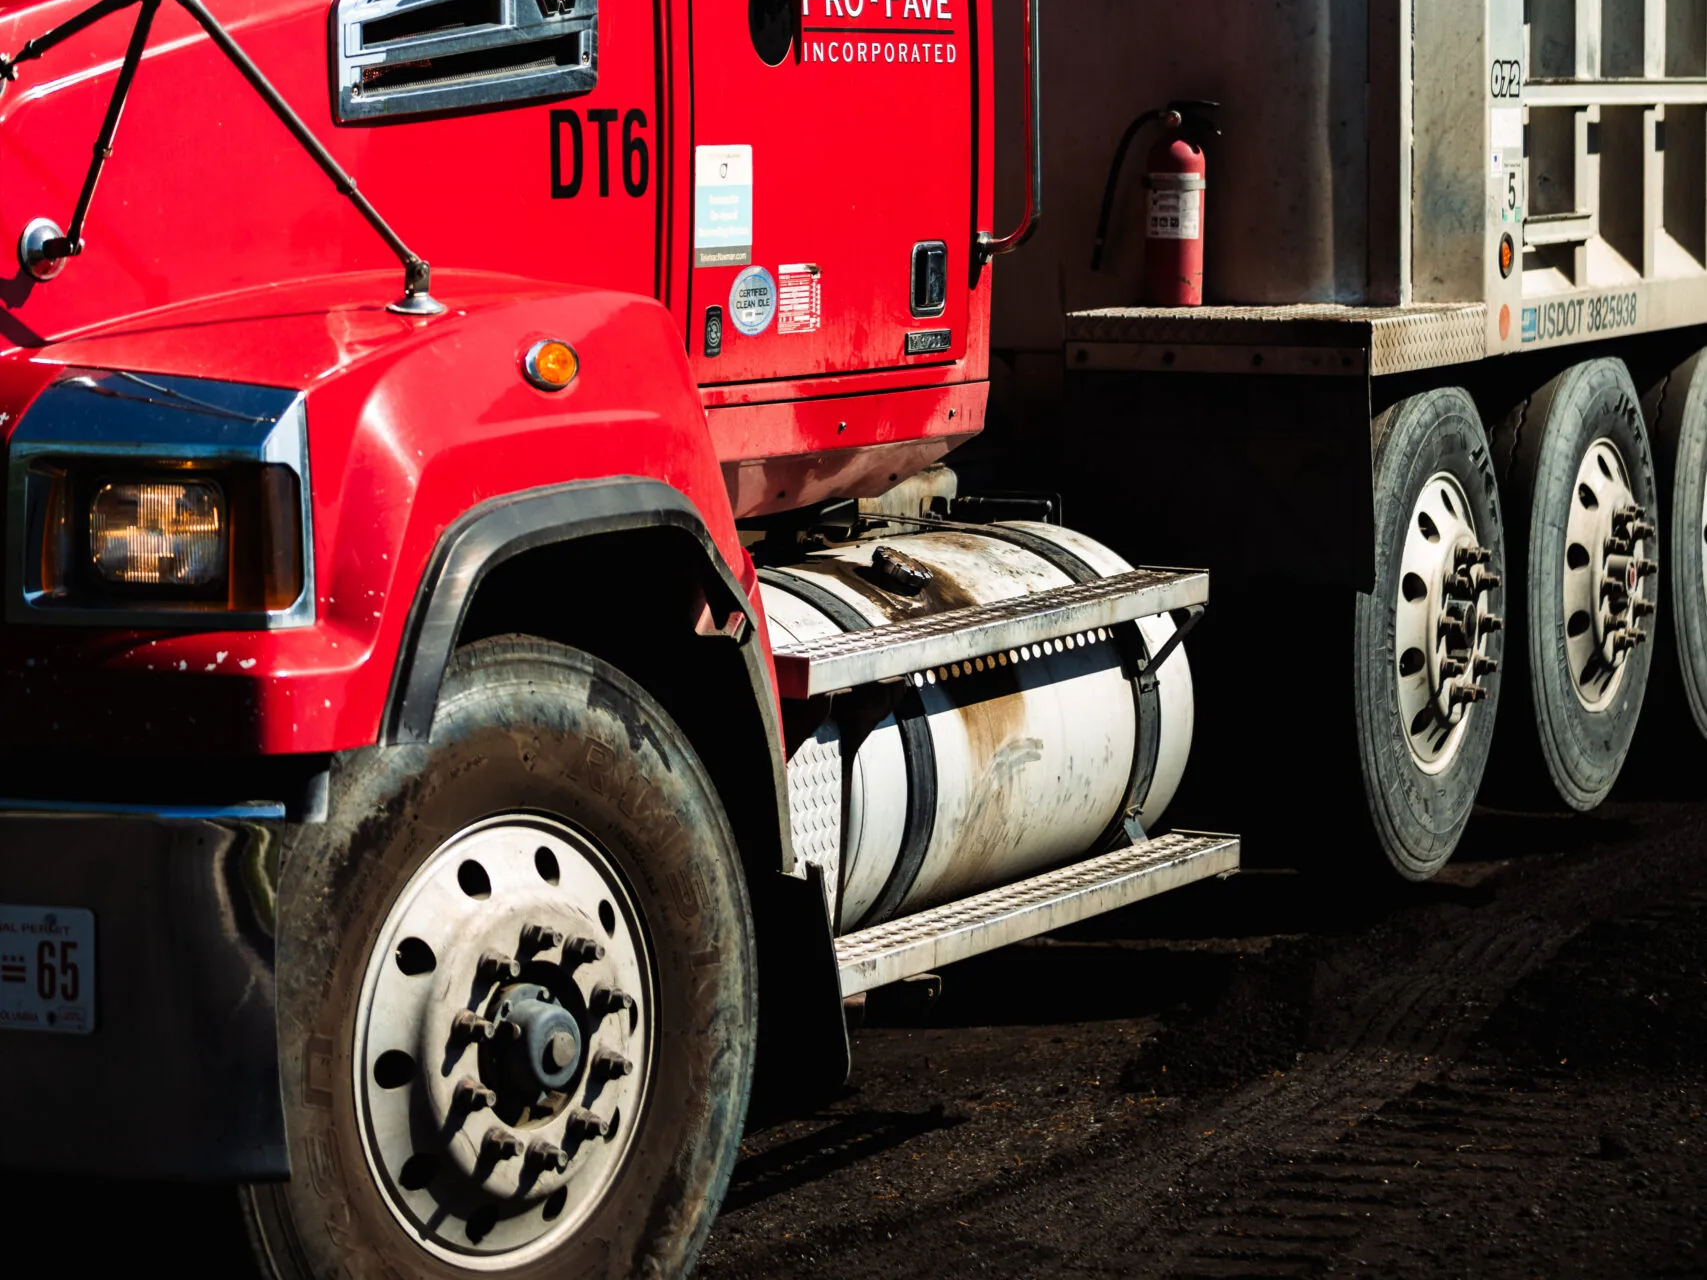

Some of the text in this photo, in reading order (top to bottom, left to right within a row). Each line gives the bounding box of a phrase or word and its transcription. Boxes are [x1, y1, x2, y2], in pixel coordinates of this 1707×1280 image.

[803, 41, 958, 64] INCORPORATED
[1491, 59, 1521, 98] 072
[549, 108, 650, 200] DT6
[1507, 171, 1517, 212] 5
[735, 298, 771, 310] CLEAN IDLE
[738, 287, 768, 298] CERTIFIED
[1536, 291, 1638, 340] USDOT 3825938
[37, 939, 80, 1002] 65
